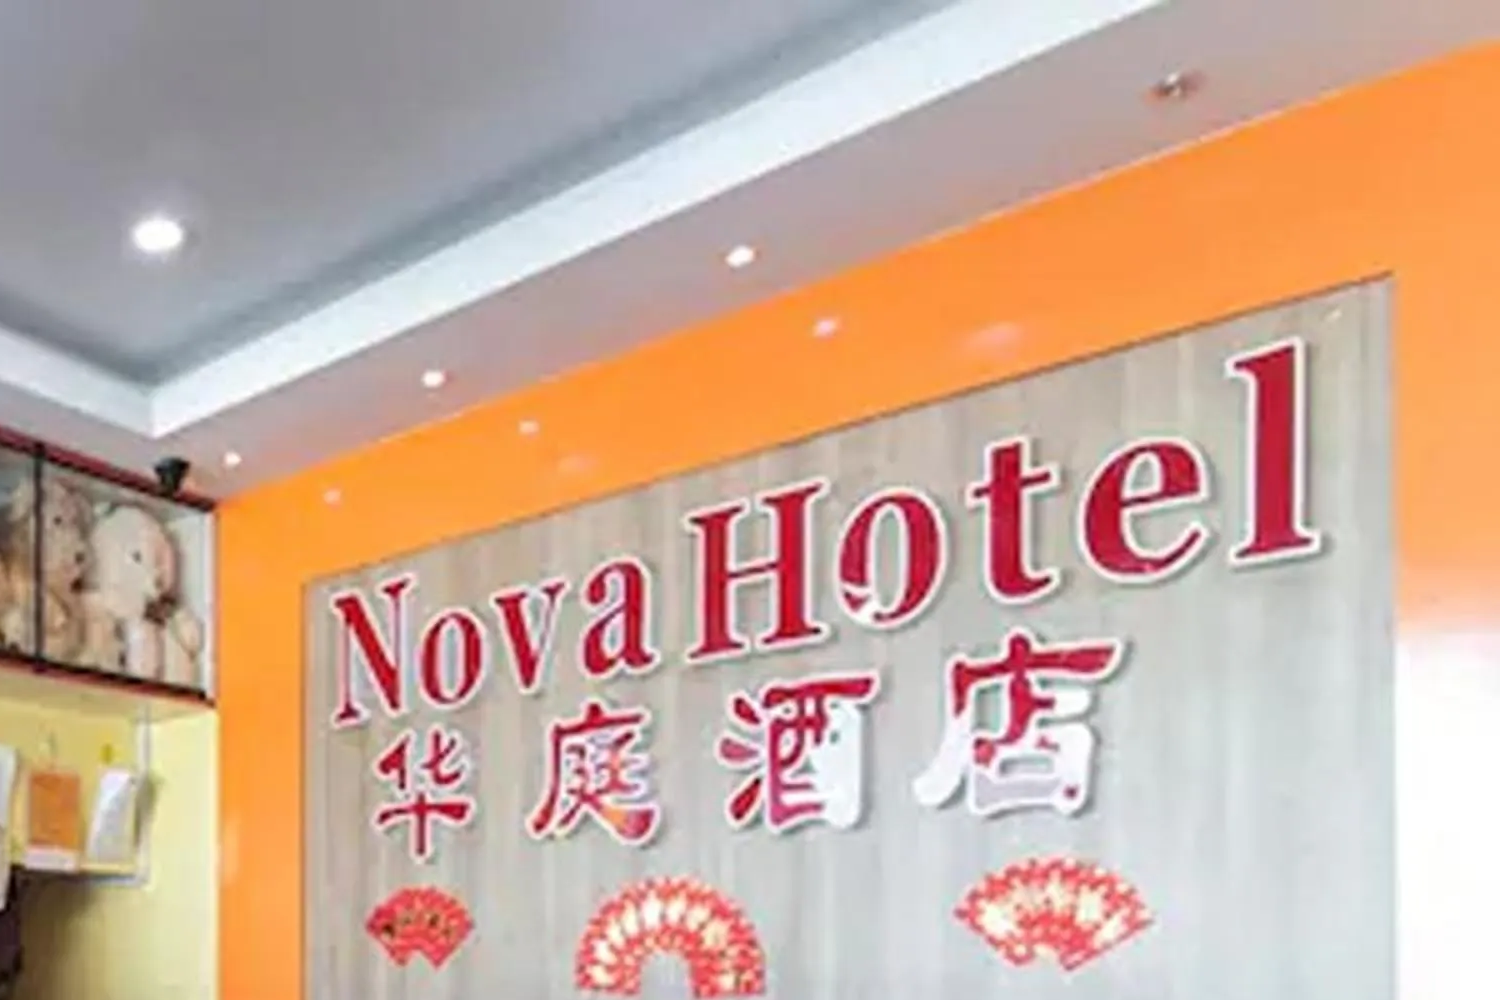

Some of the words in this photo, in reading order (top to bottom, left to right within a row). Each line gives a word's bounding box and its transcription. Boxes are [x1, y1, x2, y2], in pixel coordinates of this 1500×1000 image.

[332, 552, 654, 726] Nova
[685, 340, 1322, 660] Hotel
[373, 632, 1124, 858] 华庭酒店
